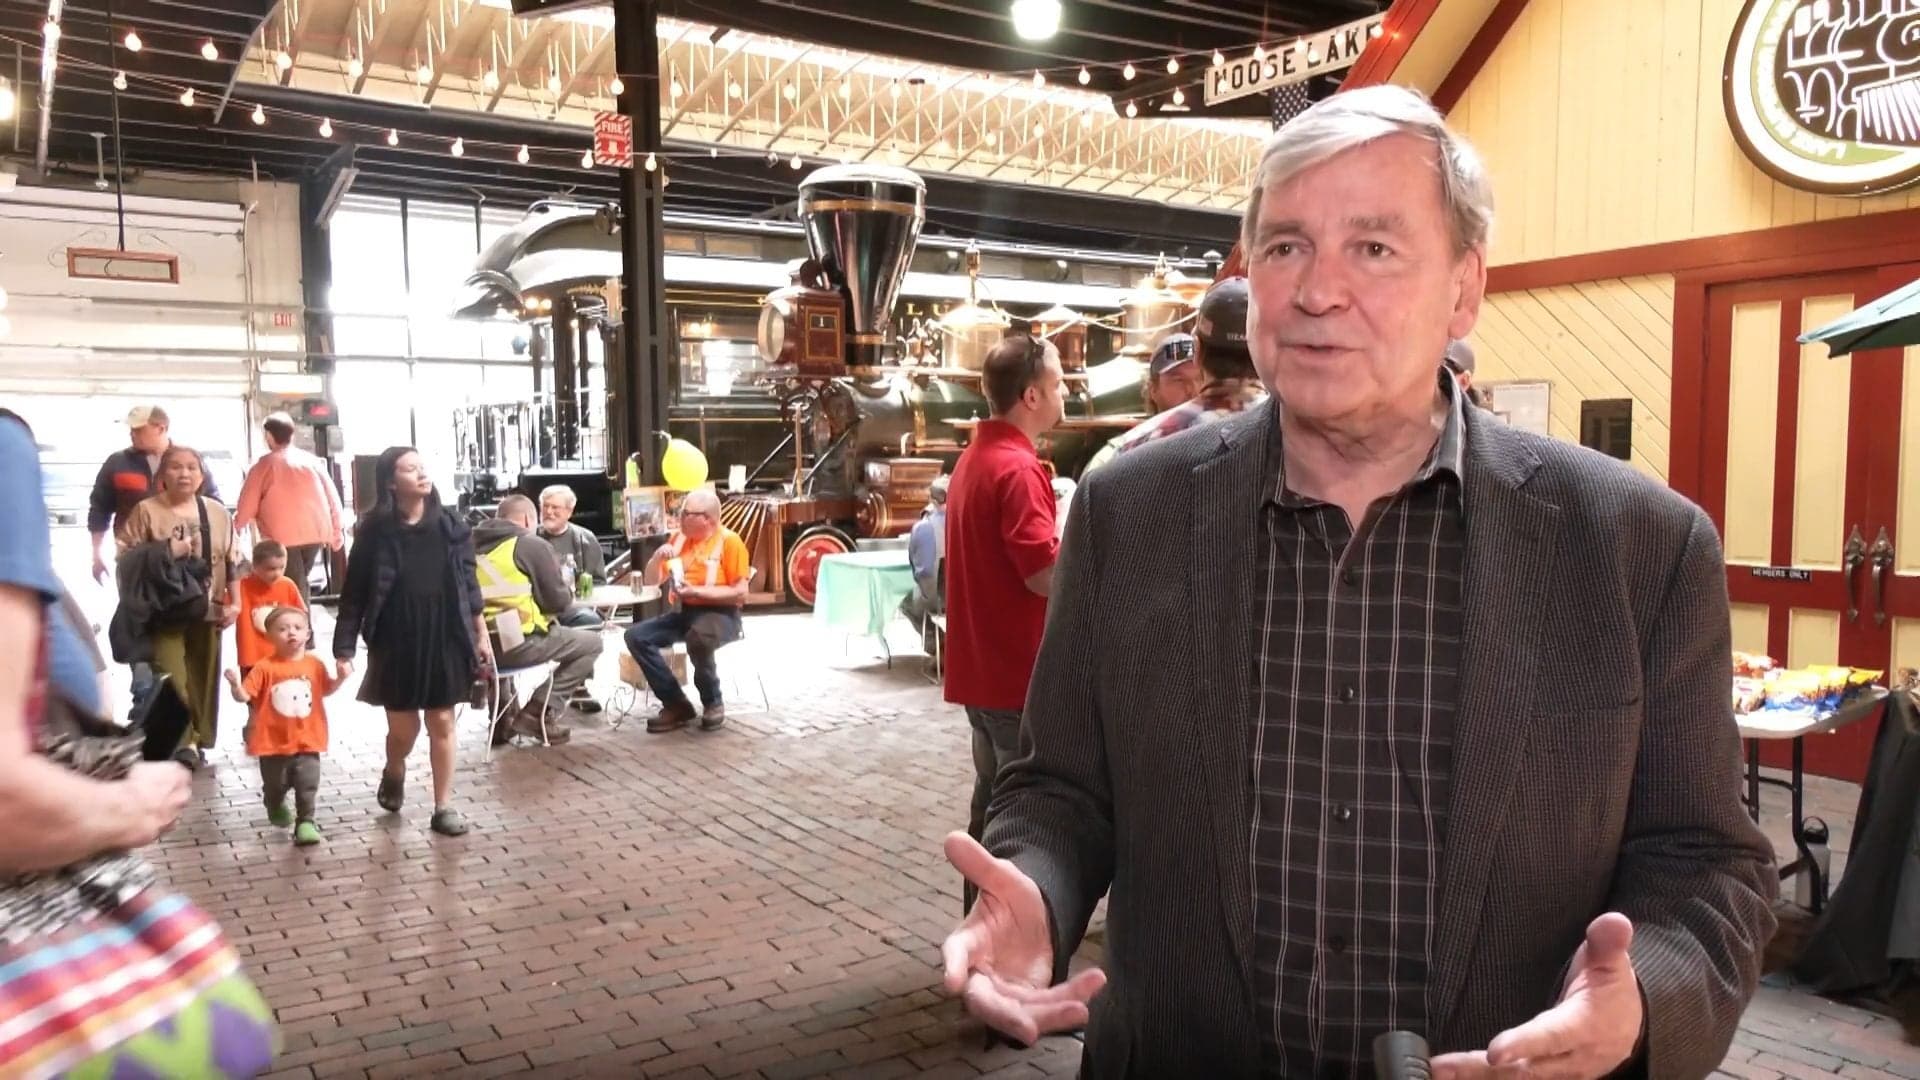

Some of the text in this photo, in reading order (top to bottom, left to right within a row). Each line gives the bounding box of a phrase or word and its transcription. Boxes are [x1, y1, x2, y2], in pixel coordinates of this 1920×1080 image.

[602, 121, 624, 134] FIRE
[274, 312, 293, 327] EXIT
[1752, 568, 1809, 579] MEMBERS ONLY
